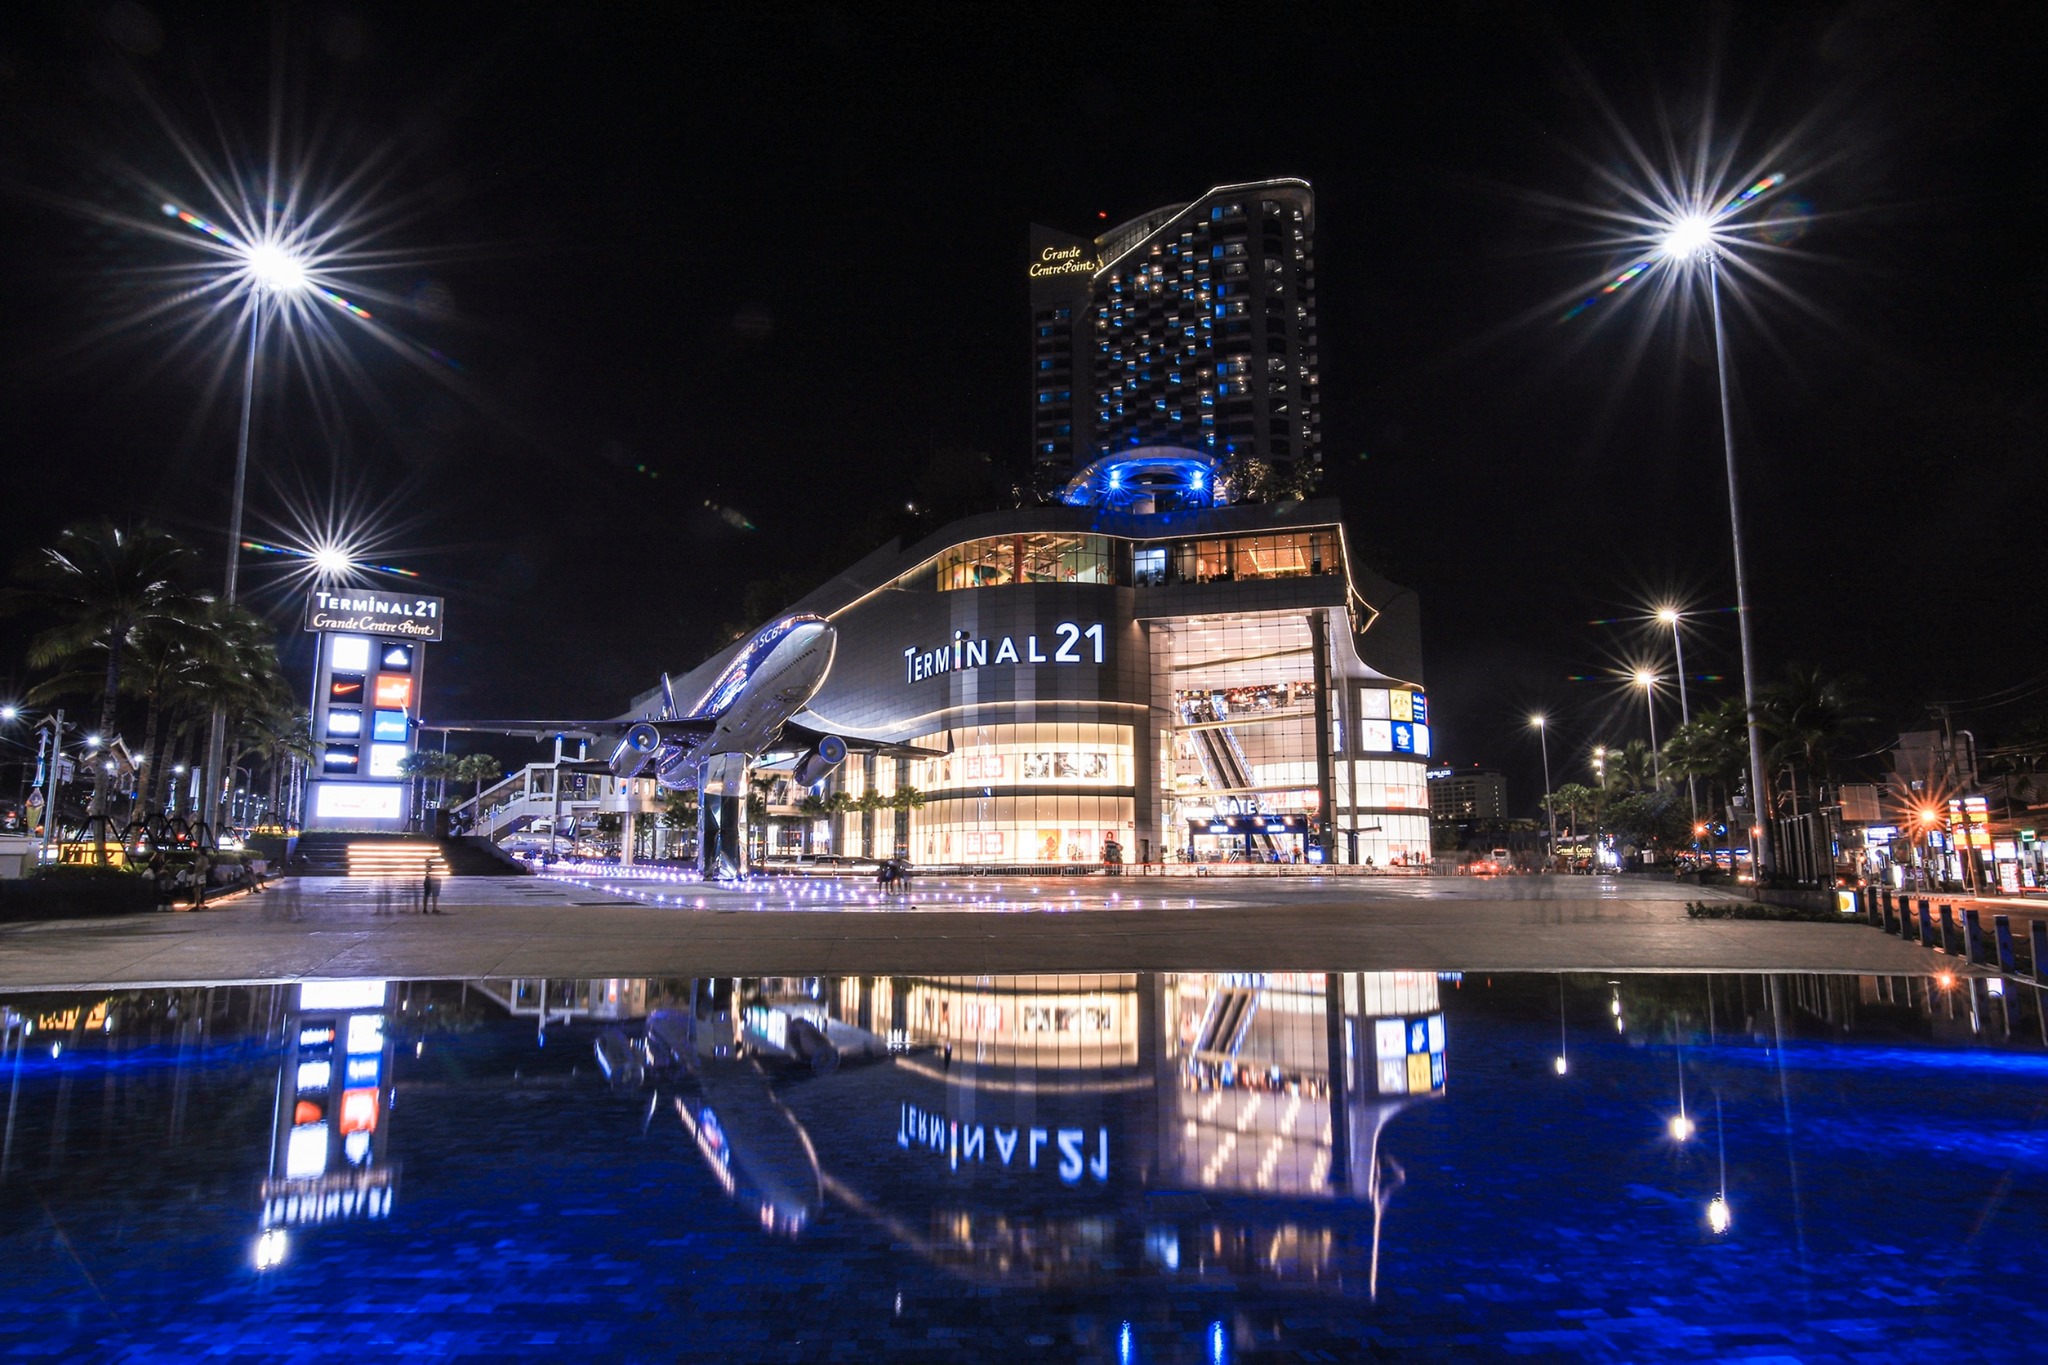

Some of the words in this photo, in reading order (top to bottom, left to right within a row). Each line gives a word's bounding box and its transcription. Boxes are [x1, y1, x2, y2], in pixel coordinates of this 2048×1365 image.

[1042, 246, 1080, 260] Grande
[1029, 263, 1062, 277] Centre
[1061, 258, 1095, 273] Point
[415, 600, 437, 618] 21
[313, 613, 358, 630] Grande
[359, 616, 397, 634] Centre
[397, 618, 435, 636] Point
[1055, 622, 1104, 663] 21
[1218, 799, 1256, 816] GATE
[1258, 800, 1269, 815] 2
